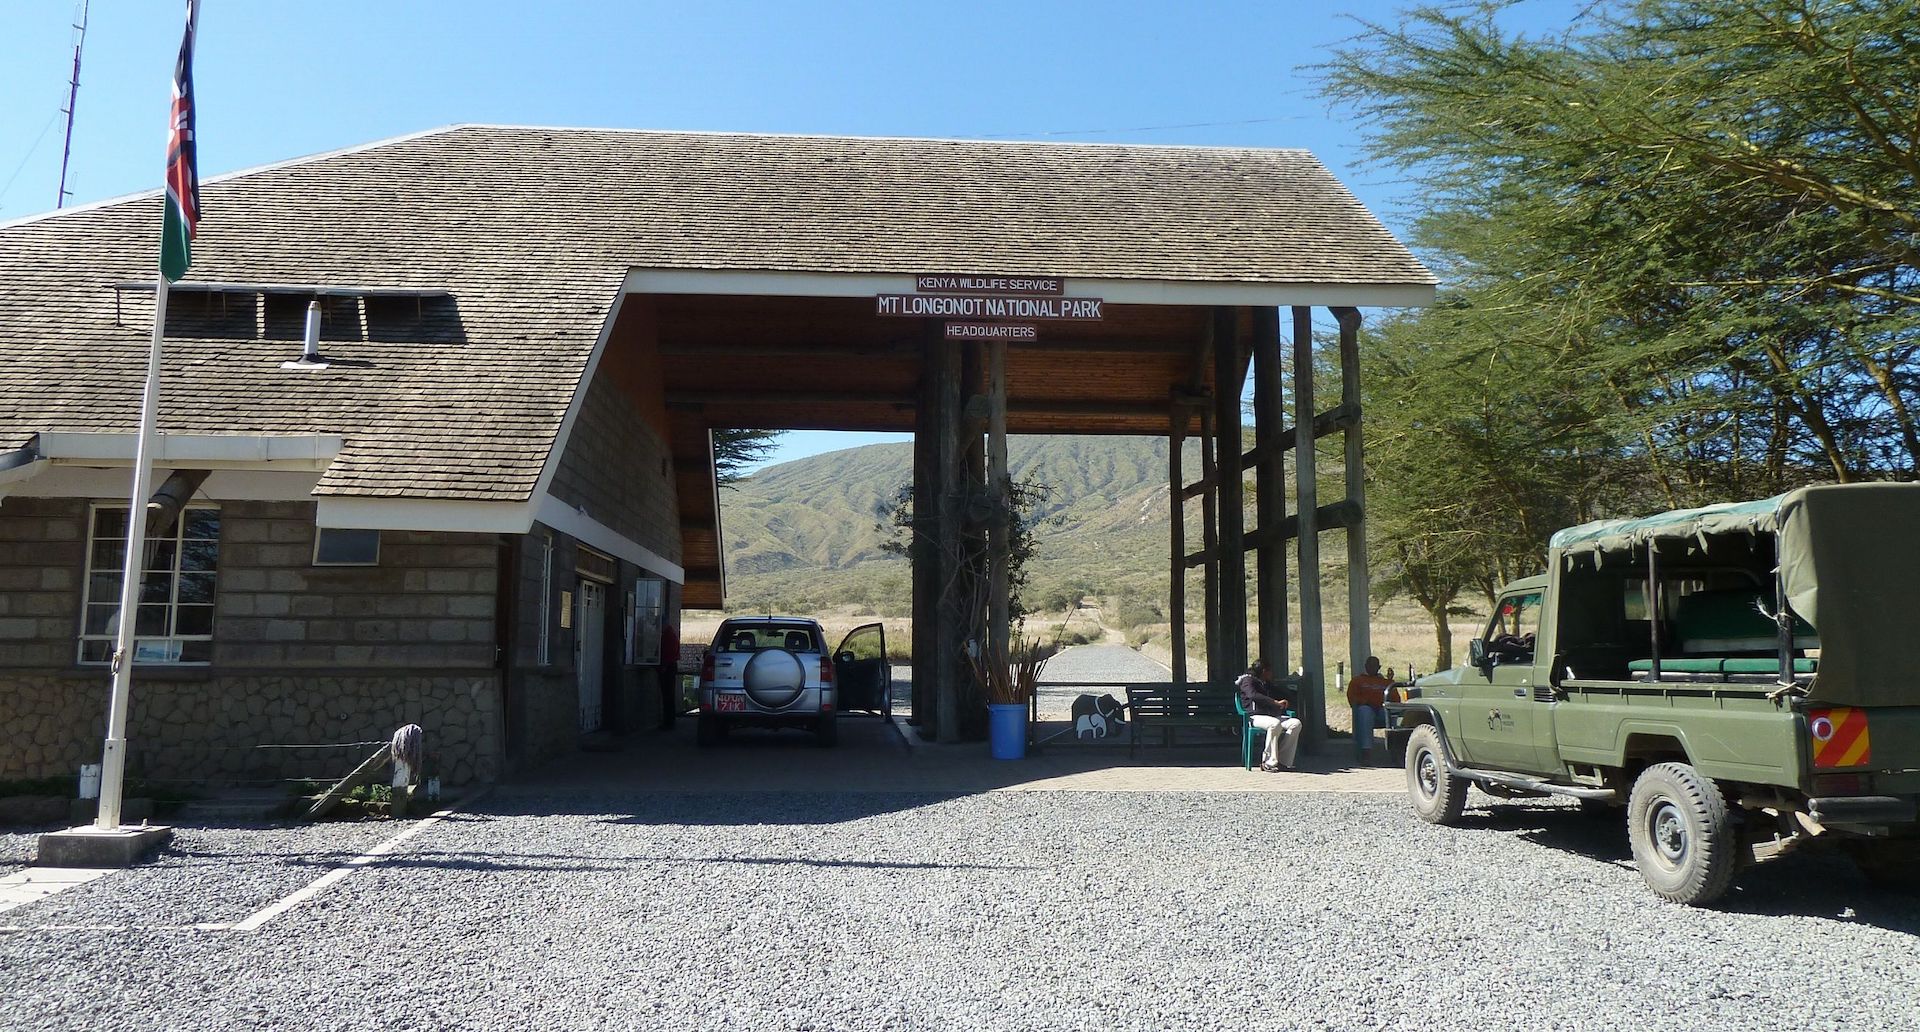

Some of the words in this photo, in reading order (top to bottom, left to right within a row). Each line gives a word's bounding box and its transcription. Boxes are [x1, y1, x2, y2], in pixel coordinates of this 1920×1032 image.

[918, 277, 957, 288] KENYA
[959, 278, 1007, 290] WILDLIFE
[1009, 280, 1057, 291] SERVICE
[878, 297, 899, 315] MT
[902, 298, 983, 316] LONGONOT
[985, 299, 1059, 317] NATIONAL
[1060, 300, 1101, 318] PARK
[946, 325, 1035, 337] HEADQUARTERS
